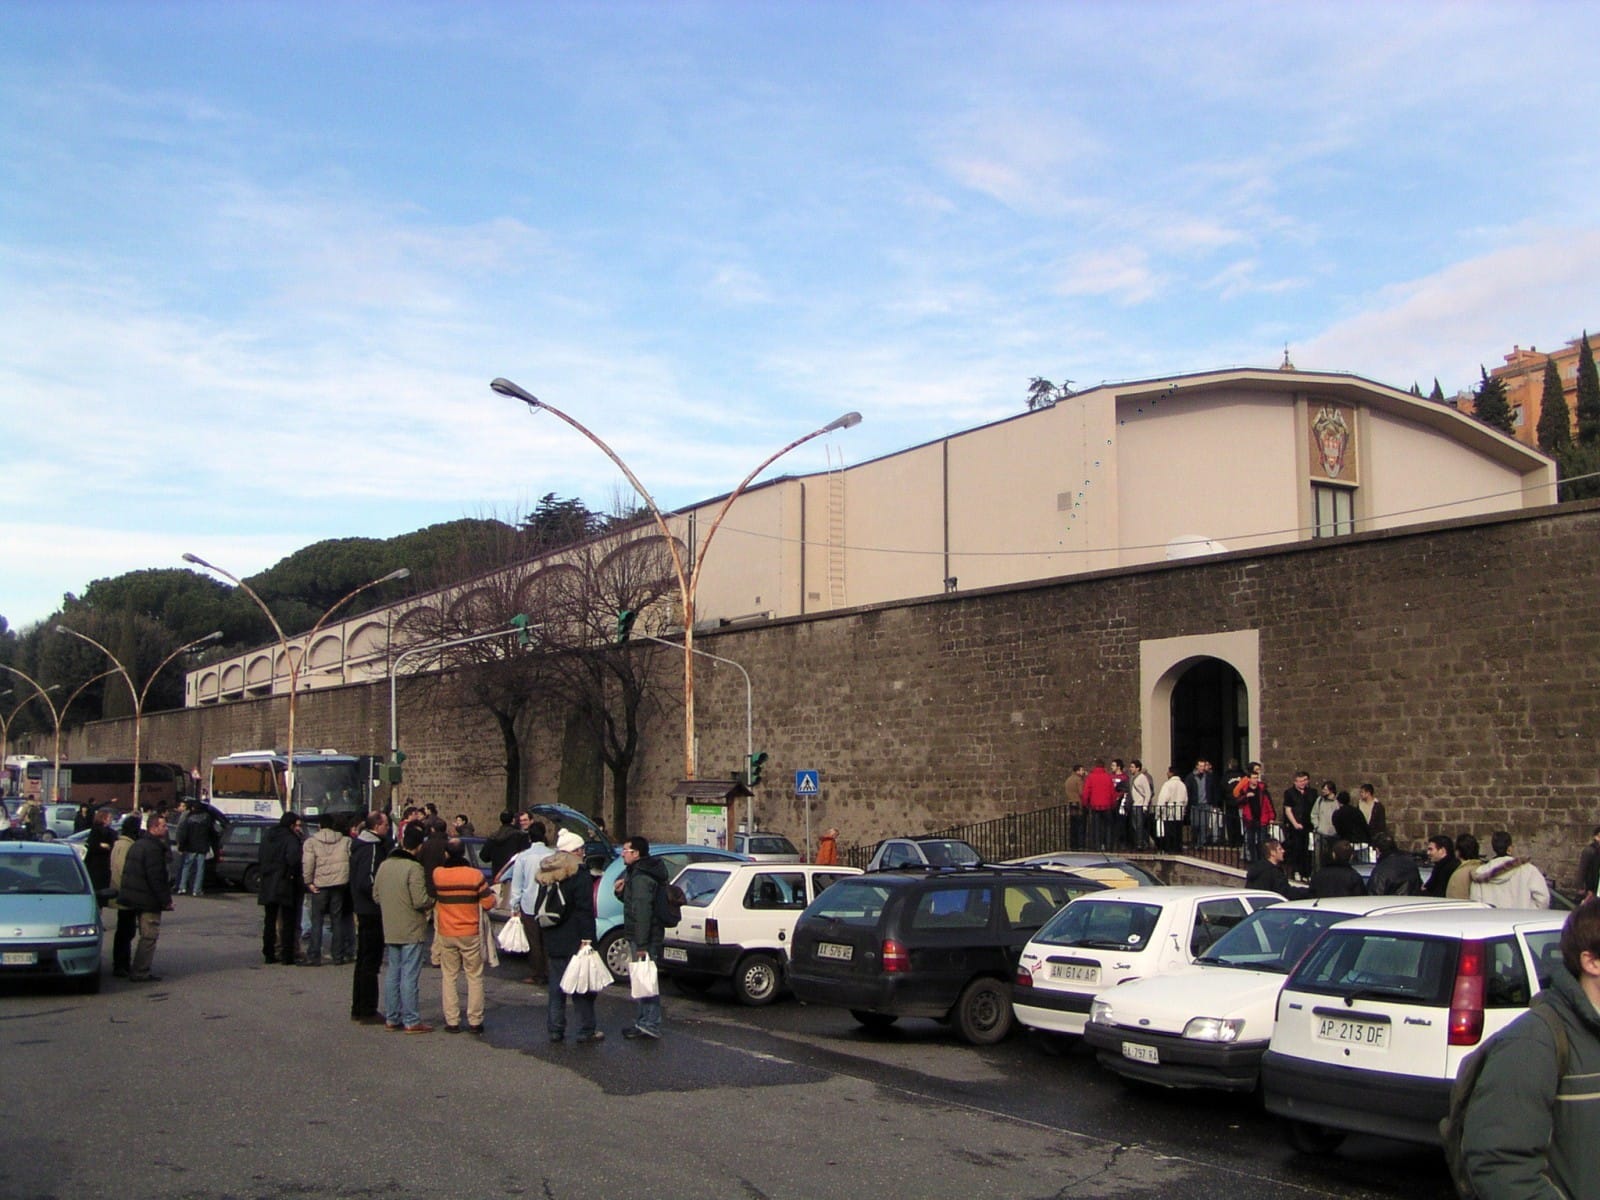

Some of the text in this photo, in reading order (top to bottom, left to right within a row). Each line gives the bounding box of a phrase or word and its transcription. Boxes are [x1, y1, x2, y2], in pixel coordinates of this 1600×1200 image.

[1320, 1019, 1384, 1044] AP 213 DF
